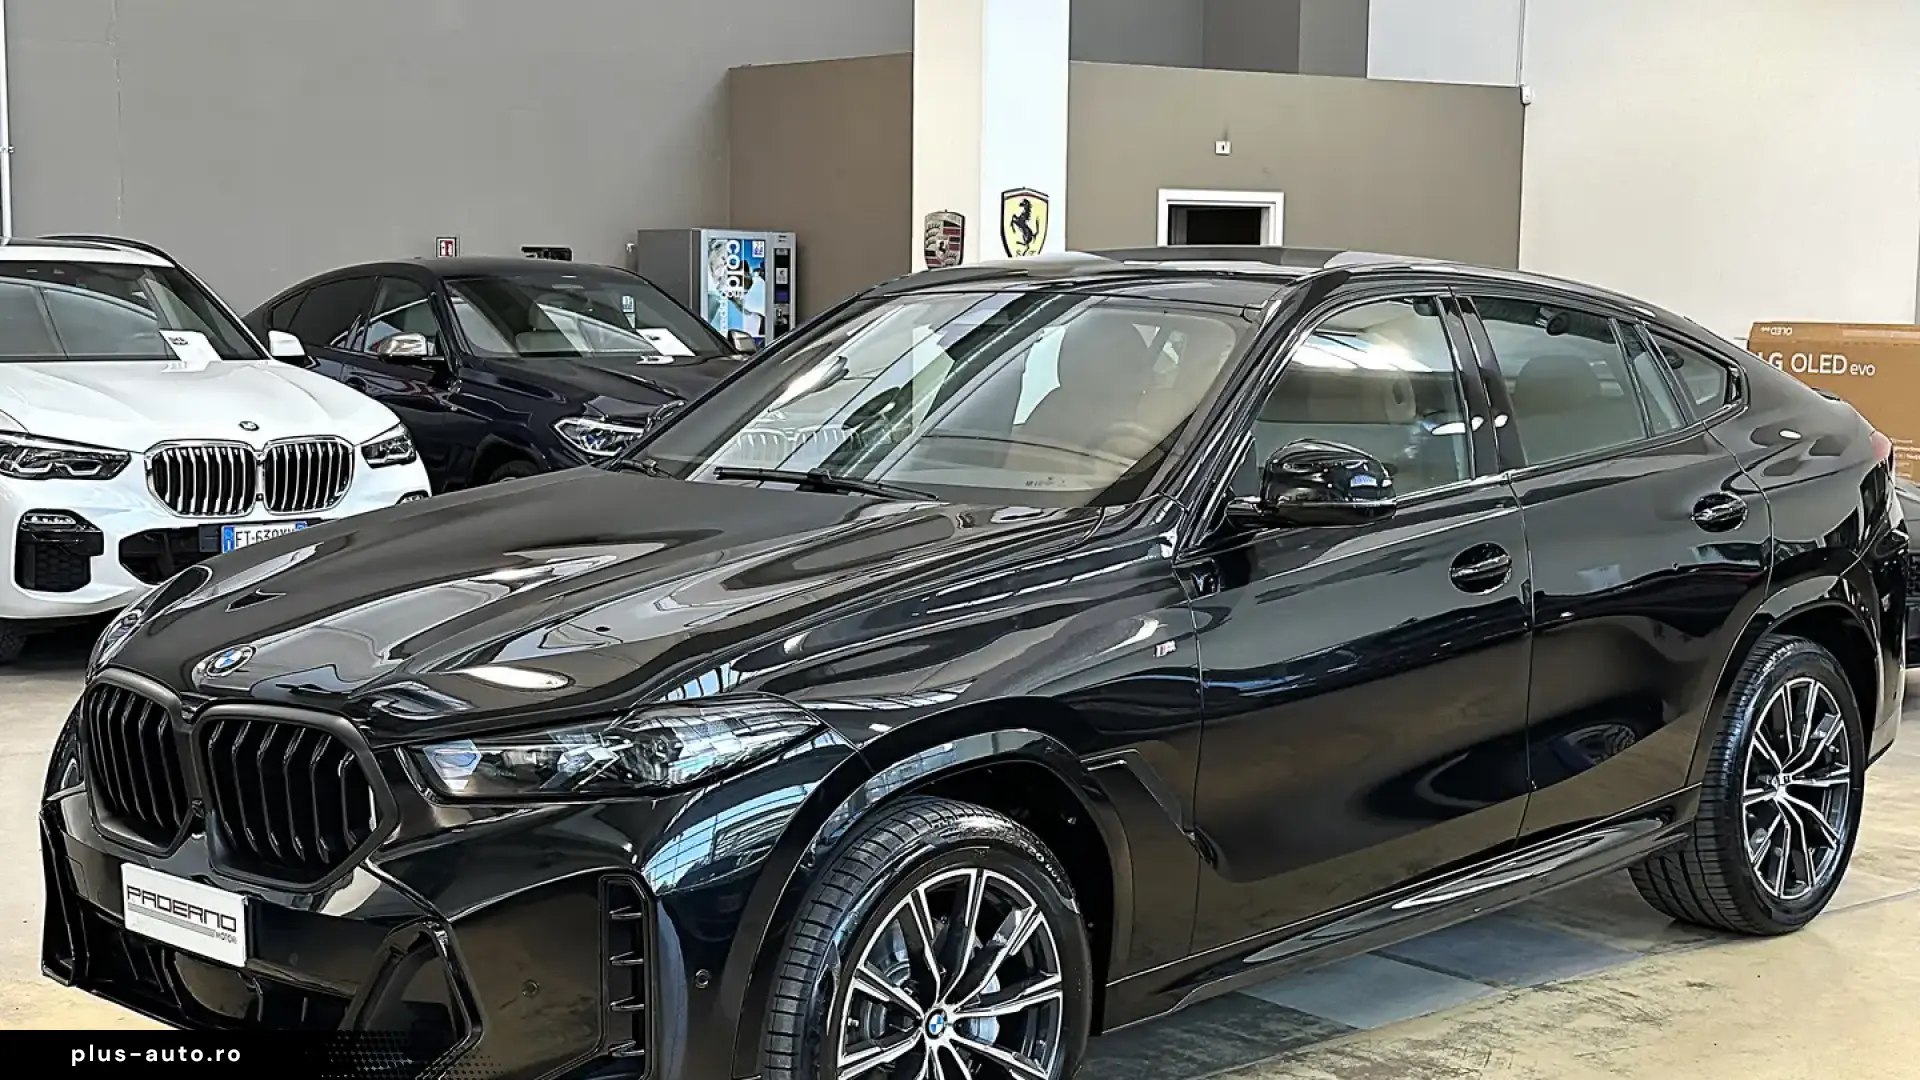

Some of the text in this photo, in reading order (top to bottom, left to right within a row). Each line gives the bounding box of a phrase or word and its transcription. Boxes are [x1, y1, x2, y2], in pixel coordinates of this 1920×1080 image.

[726, 239, 744, 292] cold
[1790, 352, 1848, 374] OLED
[1850, 363, 1876, 376] evo
[127, 884, 237, 932] PADERNO
